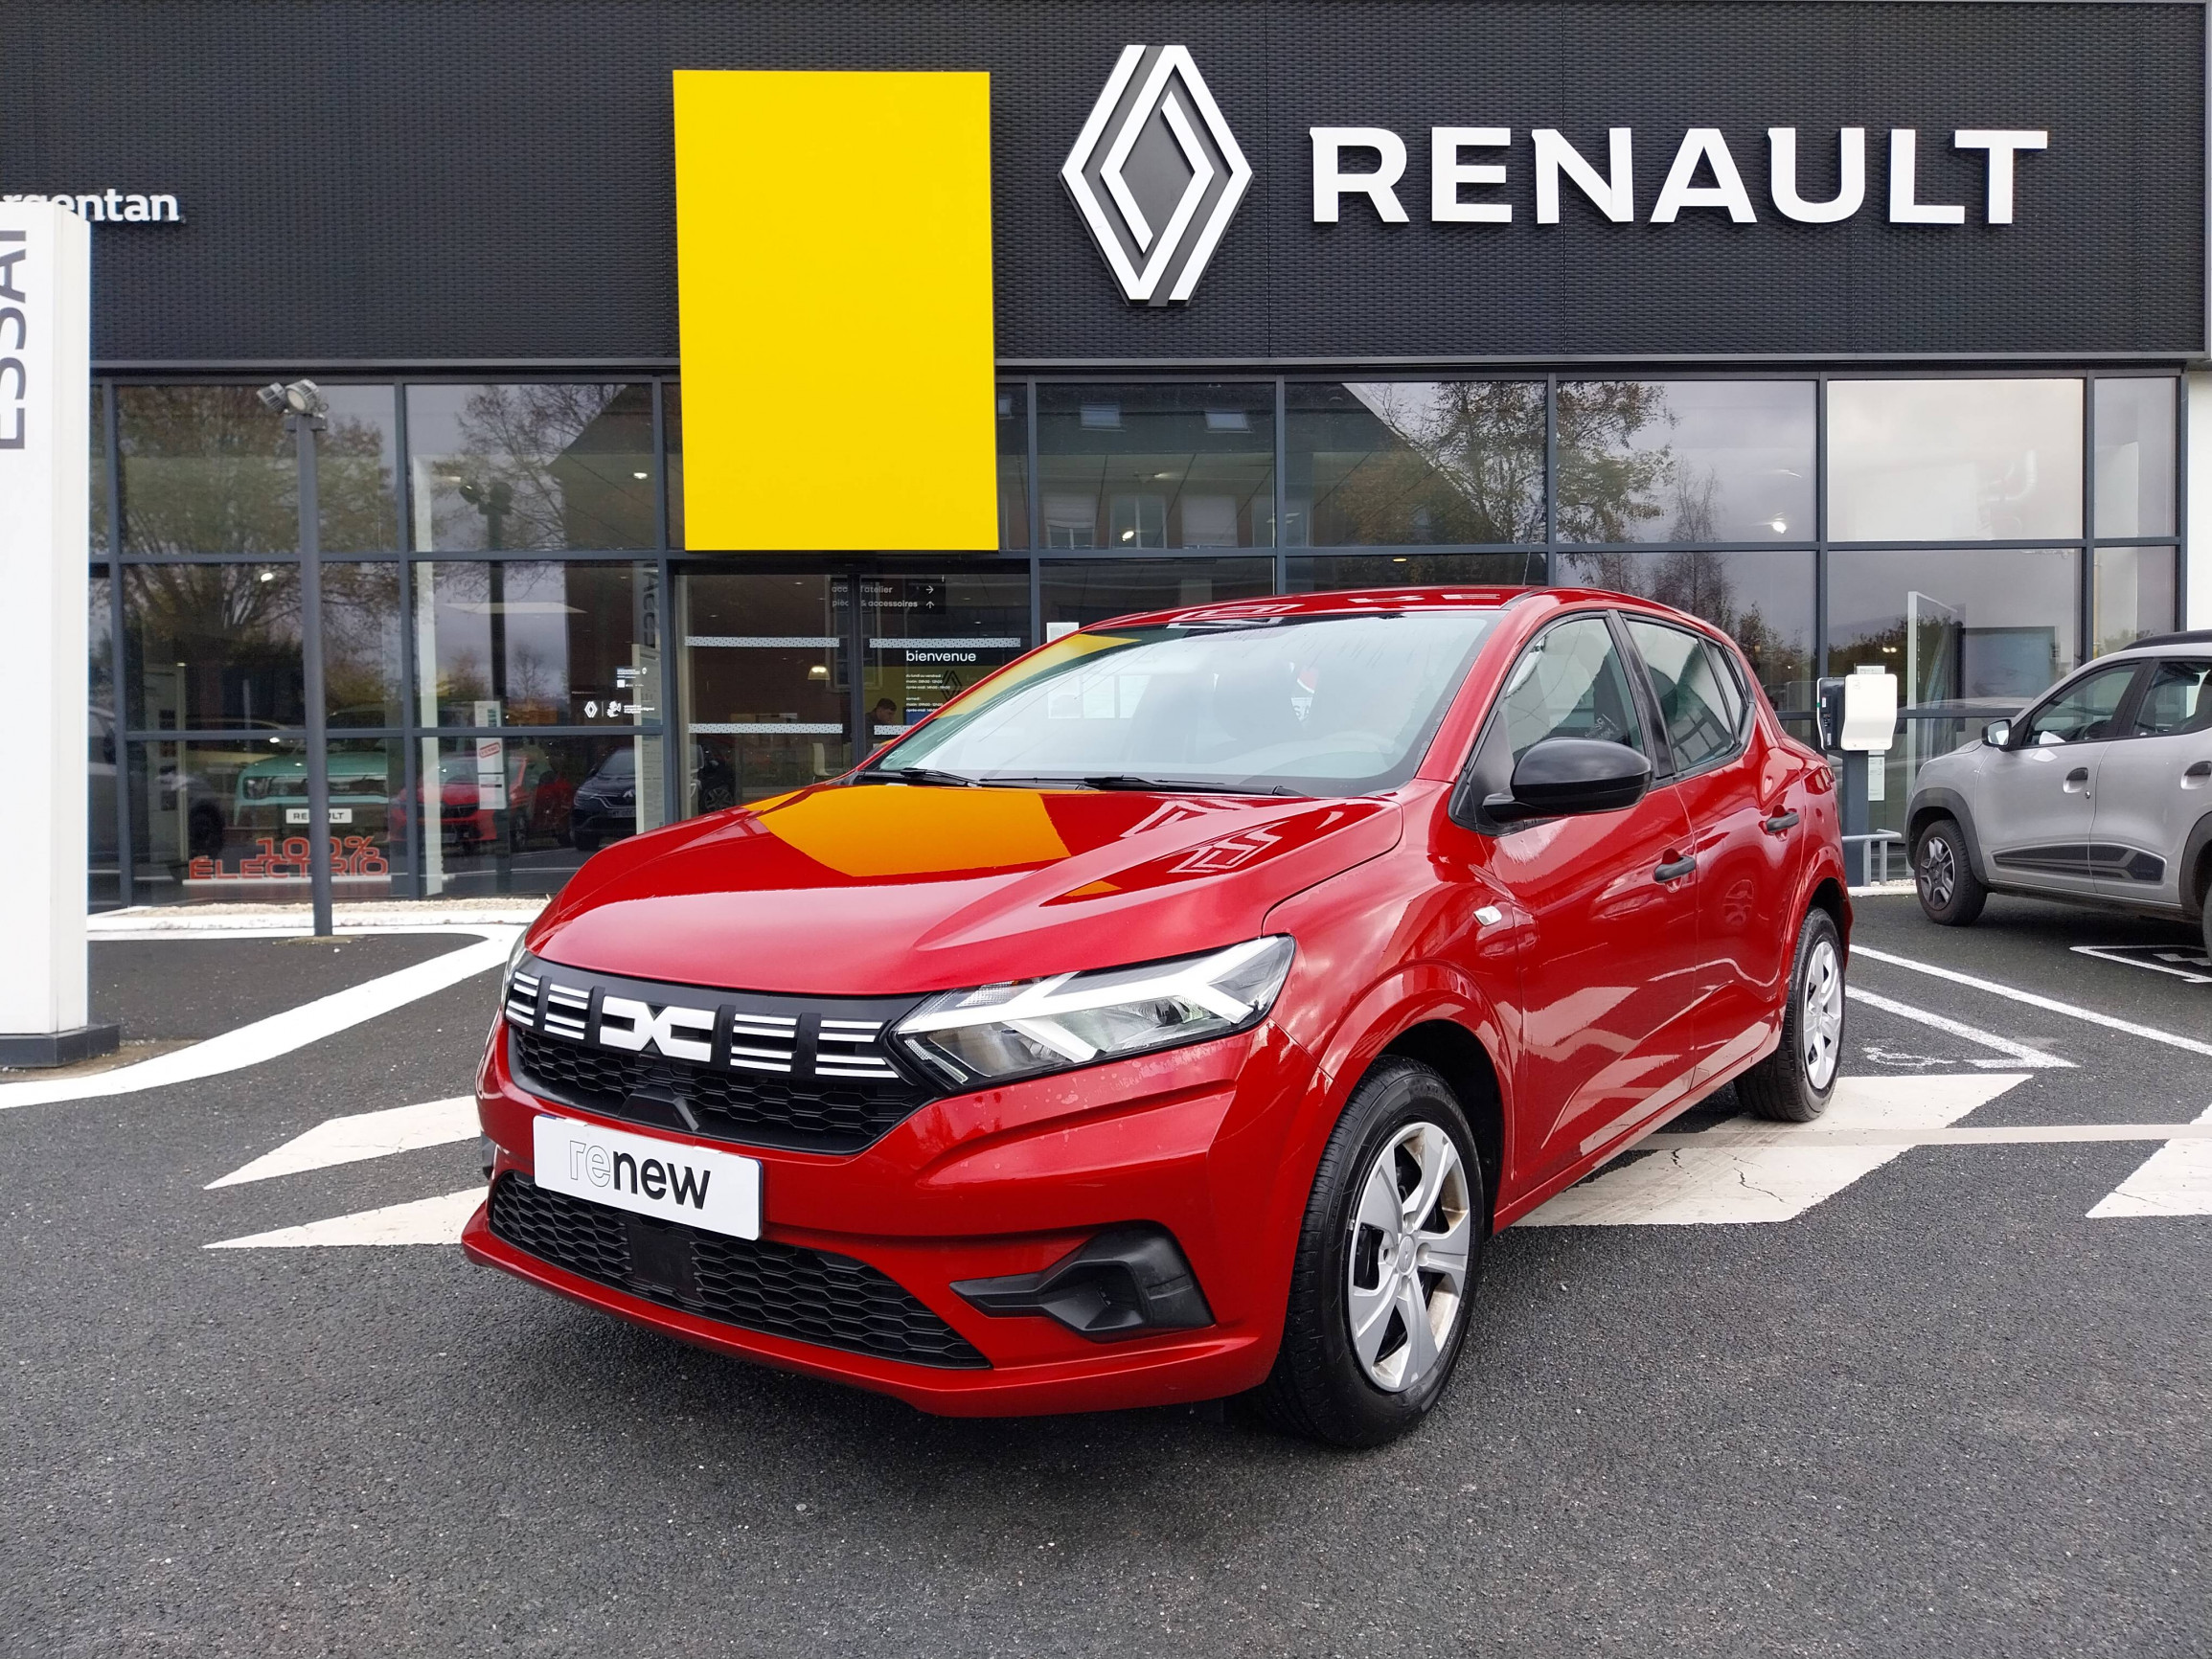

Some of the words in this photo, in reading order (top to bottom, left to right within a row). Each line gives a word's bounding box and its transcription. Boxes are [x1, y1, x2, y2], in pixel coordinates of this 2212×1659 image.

[1310, 126, 2048, 225] RENAULT
[905, 649, 977, 663] bienvenue
[292, 811, 345, 821] RELT
[569, 1140, 711, 1210] renew
